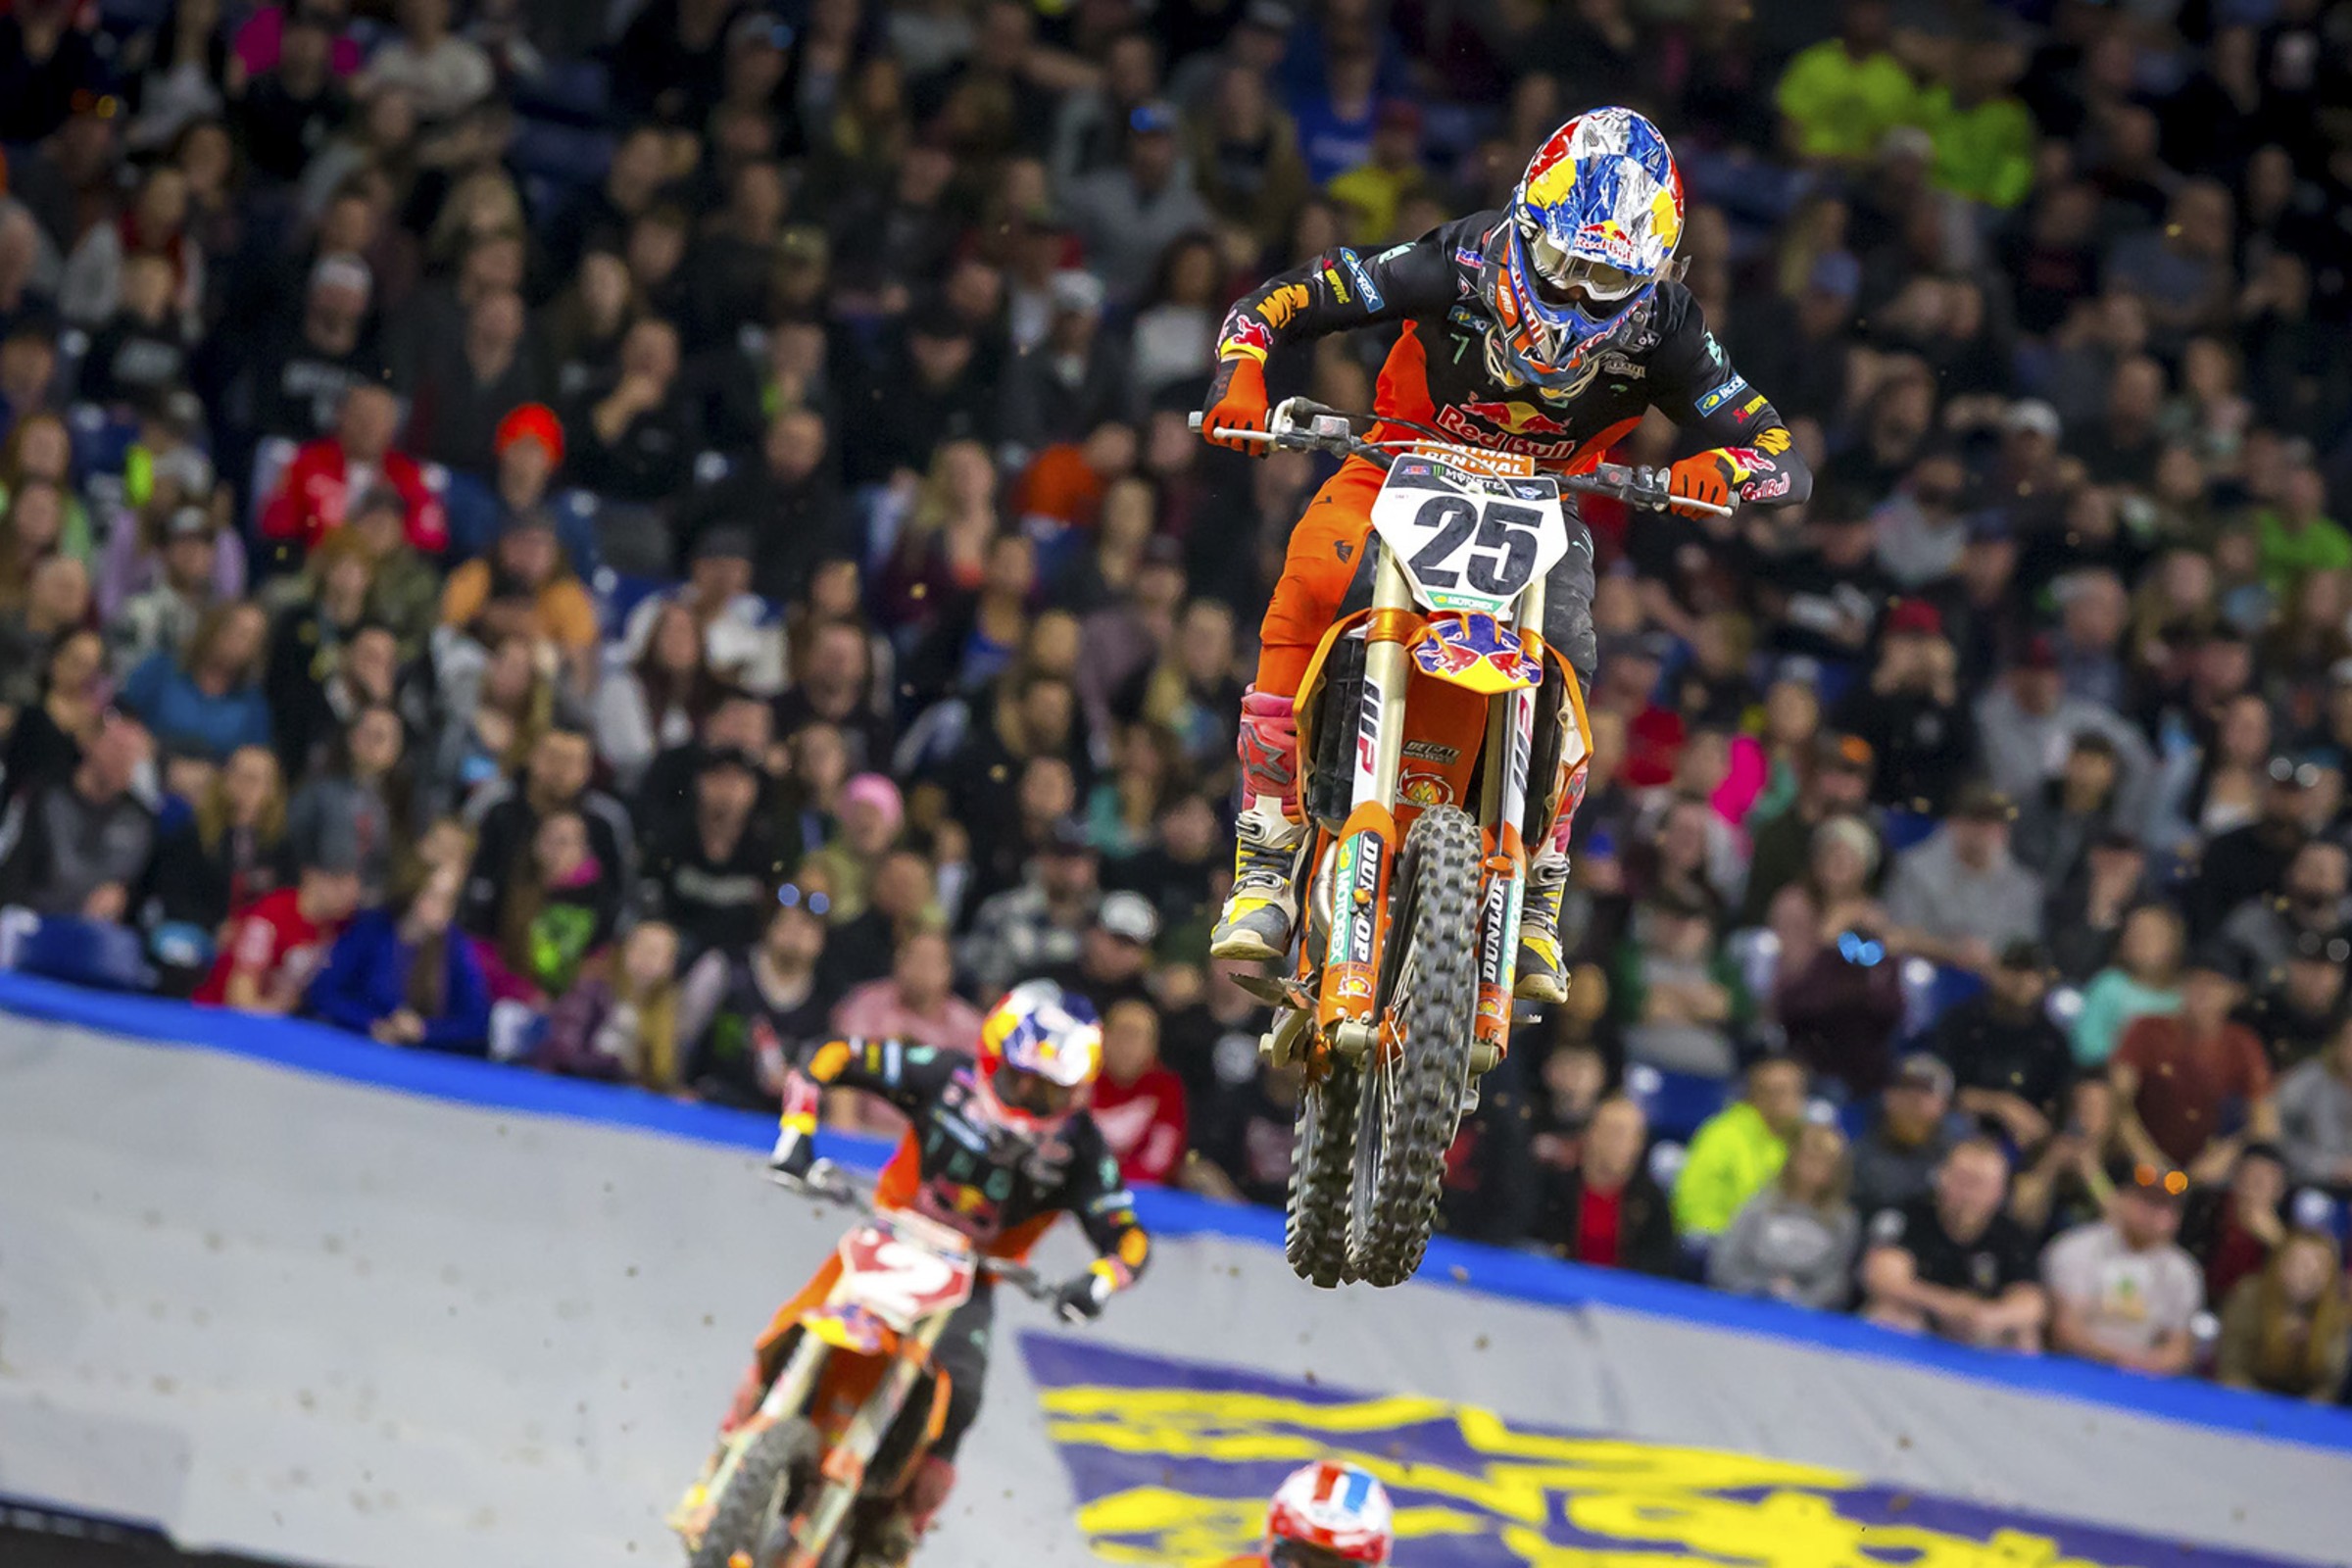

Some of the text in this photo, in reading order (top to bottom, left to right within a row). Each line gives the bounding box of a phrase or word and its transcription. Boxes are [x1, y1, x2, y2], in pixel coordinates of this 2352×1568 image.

[1436, 403, 1576, 460] Red Bull
[1408, 496, 1544, 596] 25
[1446, 596, 1495, 612] MOTOREX
[1330, 870, 1351, 963] MOTOREX
[1354, 835, 1379, 962] DUNOP
